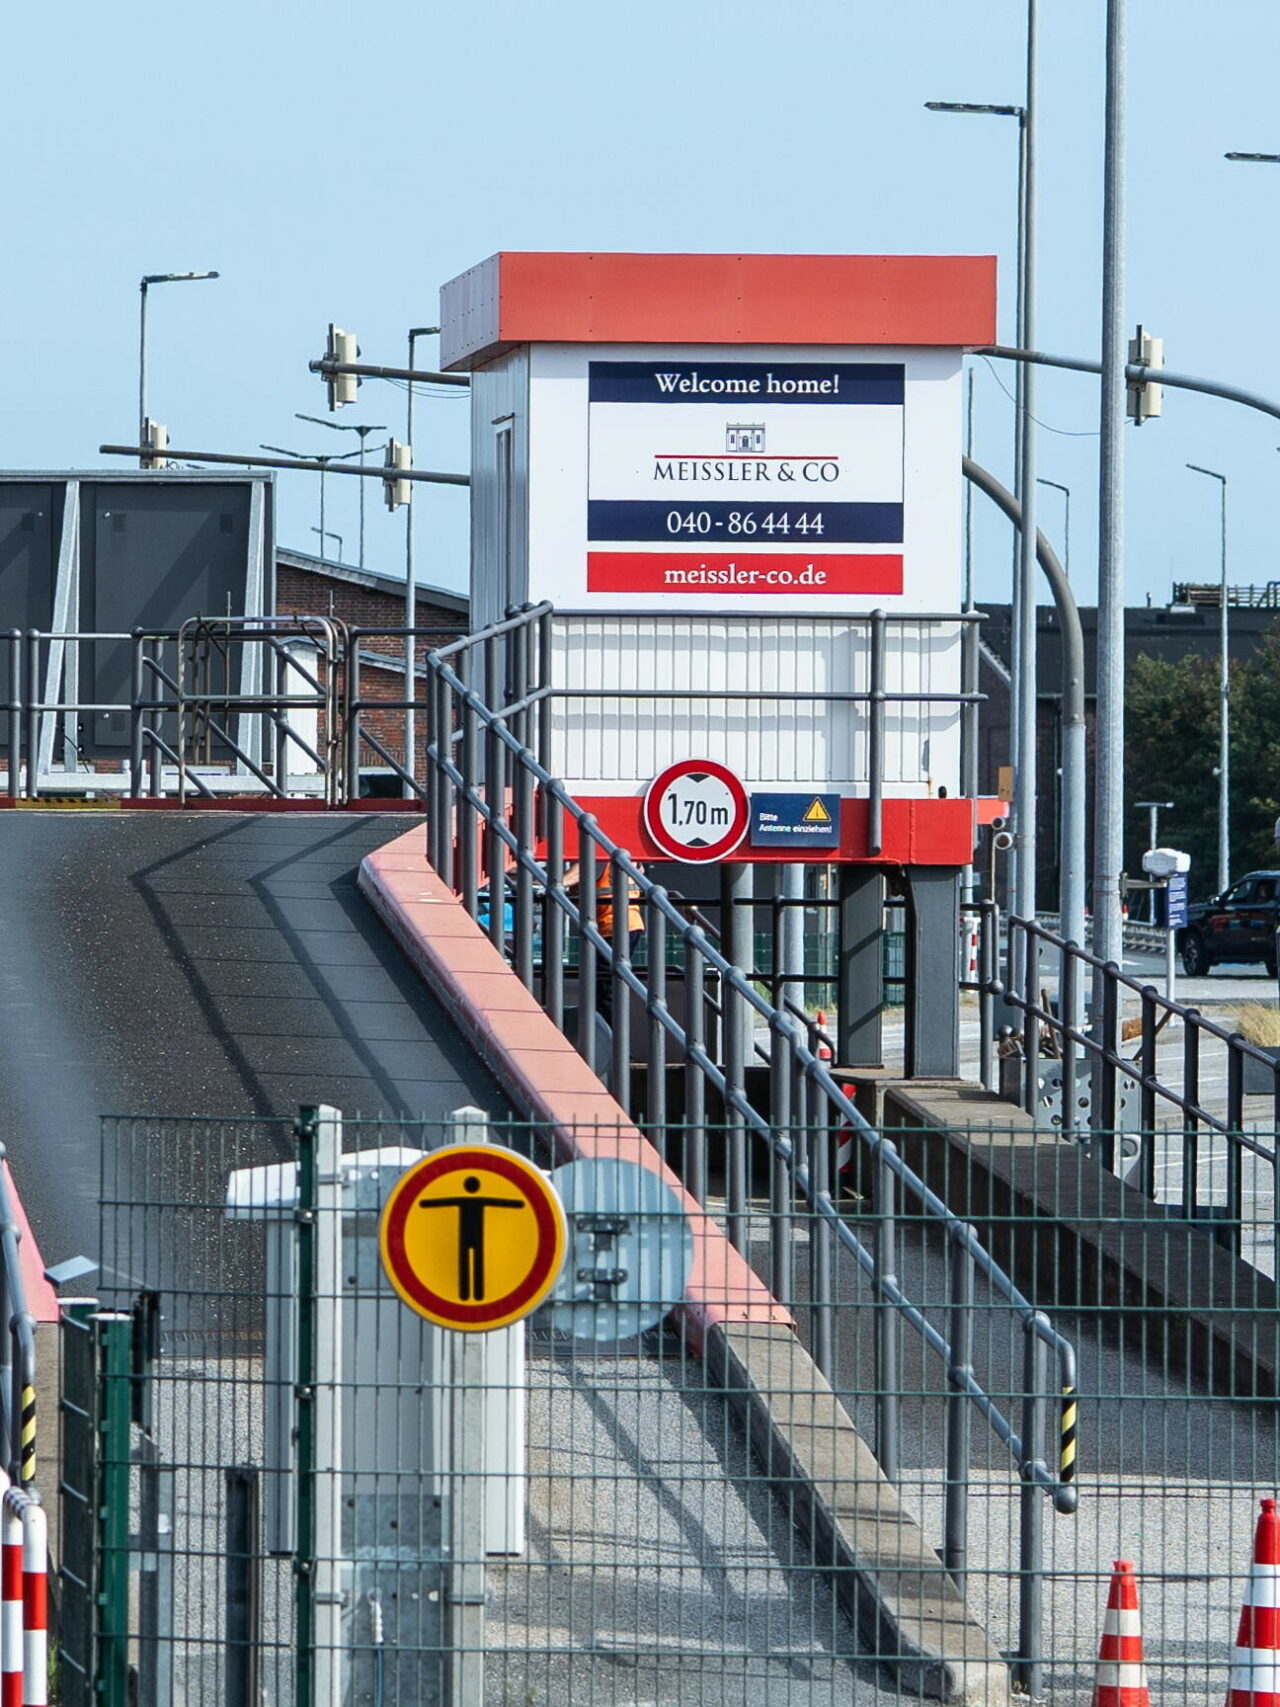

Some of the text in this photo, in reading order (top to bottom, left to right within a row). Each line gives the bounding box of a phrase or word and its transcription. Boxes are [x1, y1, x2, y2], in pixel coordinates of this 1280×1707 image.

[655, 372, 839, 394] Welcome home!
[653, 461, 840, 482] MEISSLER & CO
[664, 563, 827, 585] meissler-co.de
[667, 793, 728, 826] 1,70 m
